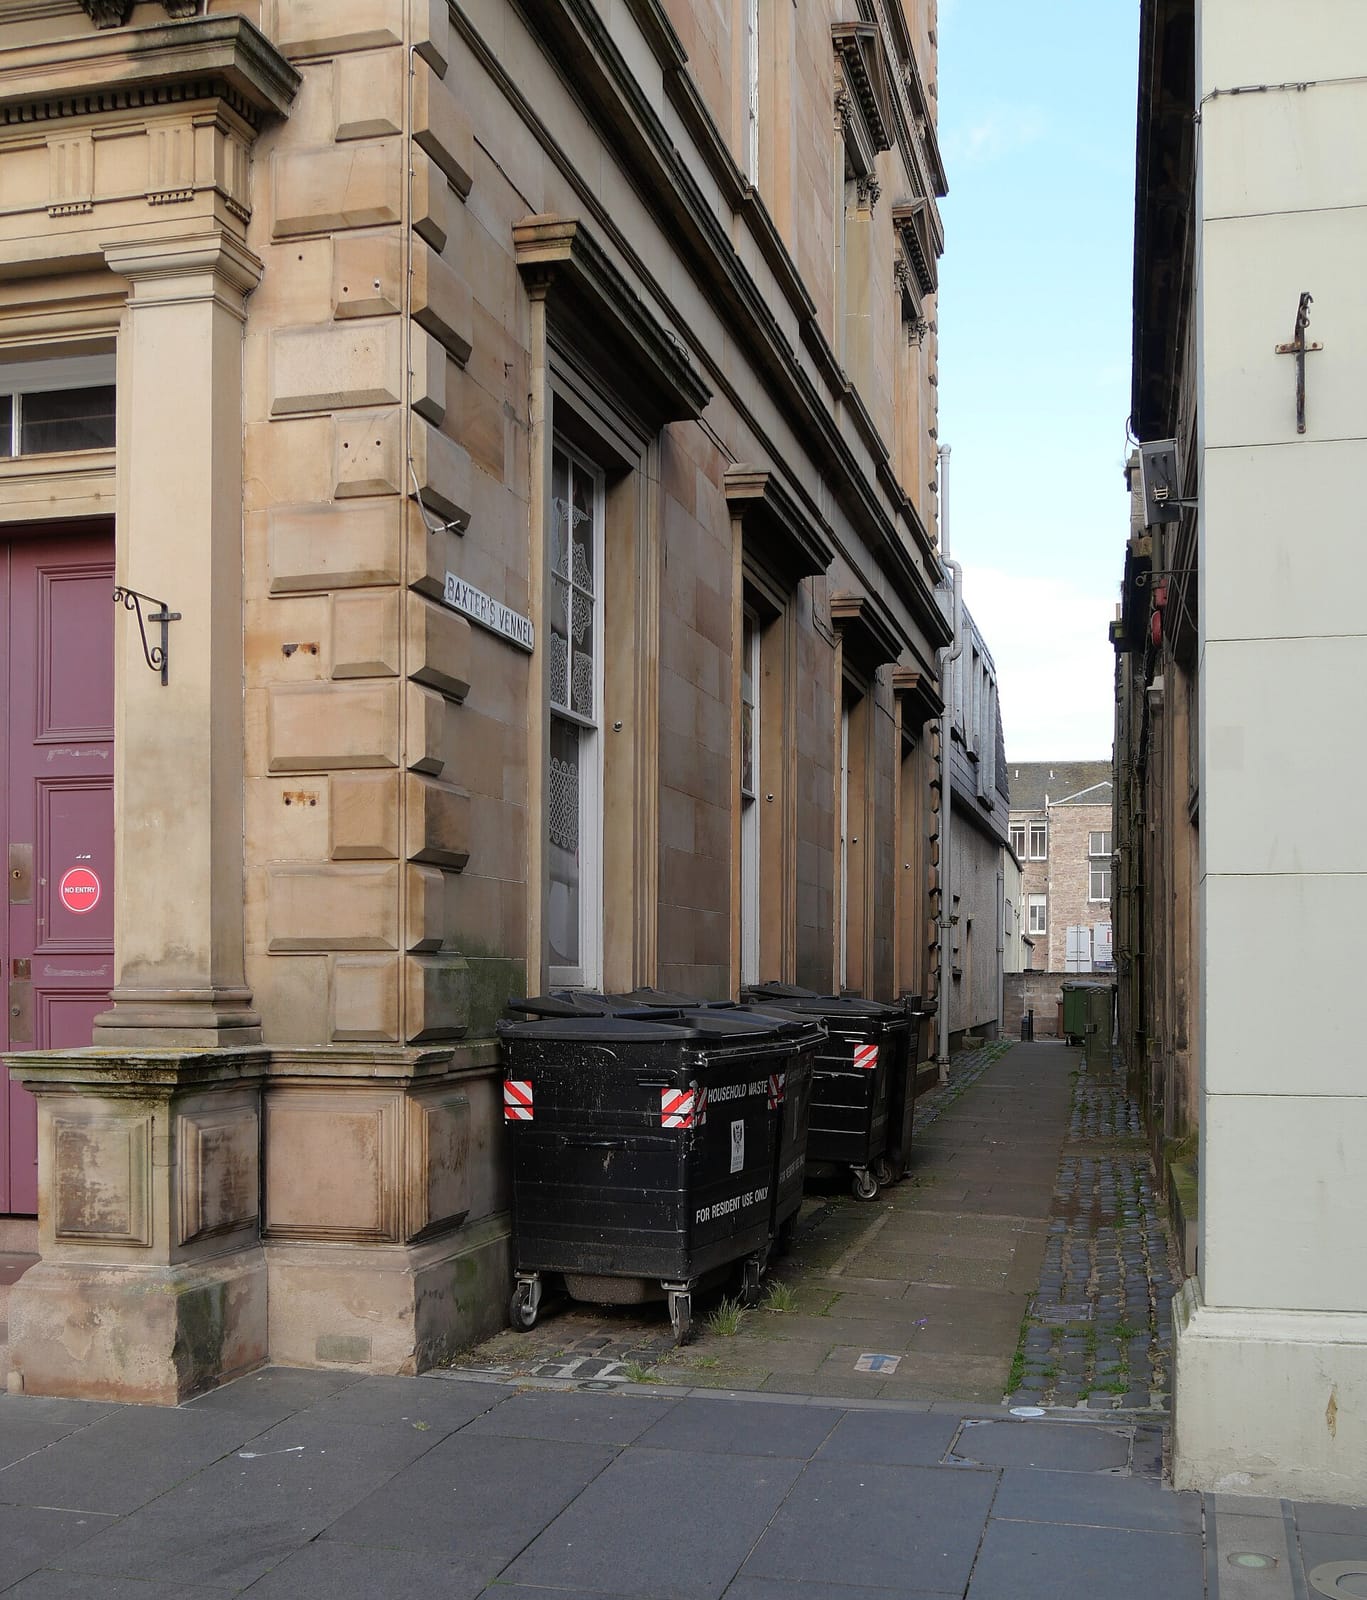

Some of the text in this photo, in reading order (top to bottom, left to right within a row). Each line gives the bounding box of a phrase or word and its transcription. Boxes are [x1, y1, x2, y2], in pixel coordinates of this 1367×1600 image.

[447, 577, 532, 646] BAXTER'S VENNEL
[708, 1080, 768, 1103] HOUSEHOLD WASTE
[696, 1186, 769, 1224] FOR RESIDENT USE ONLY
